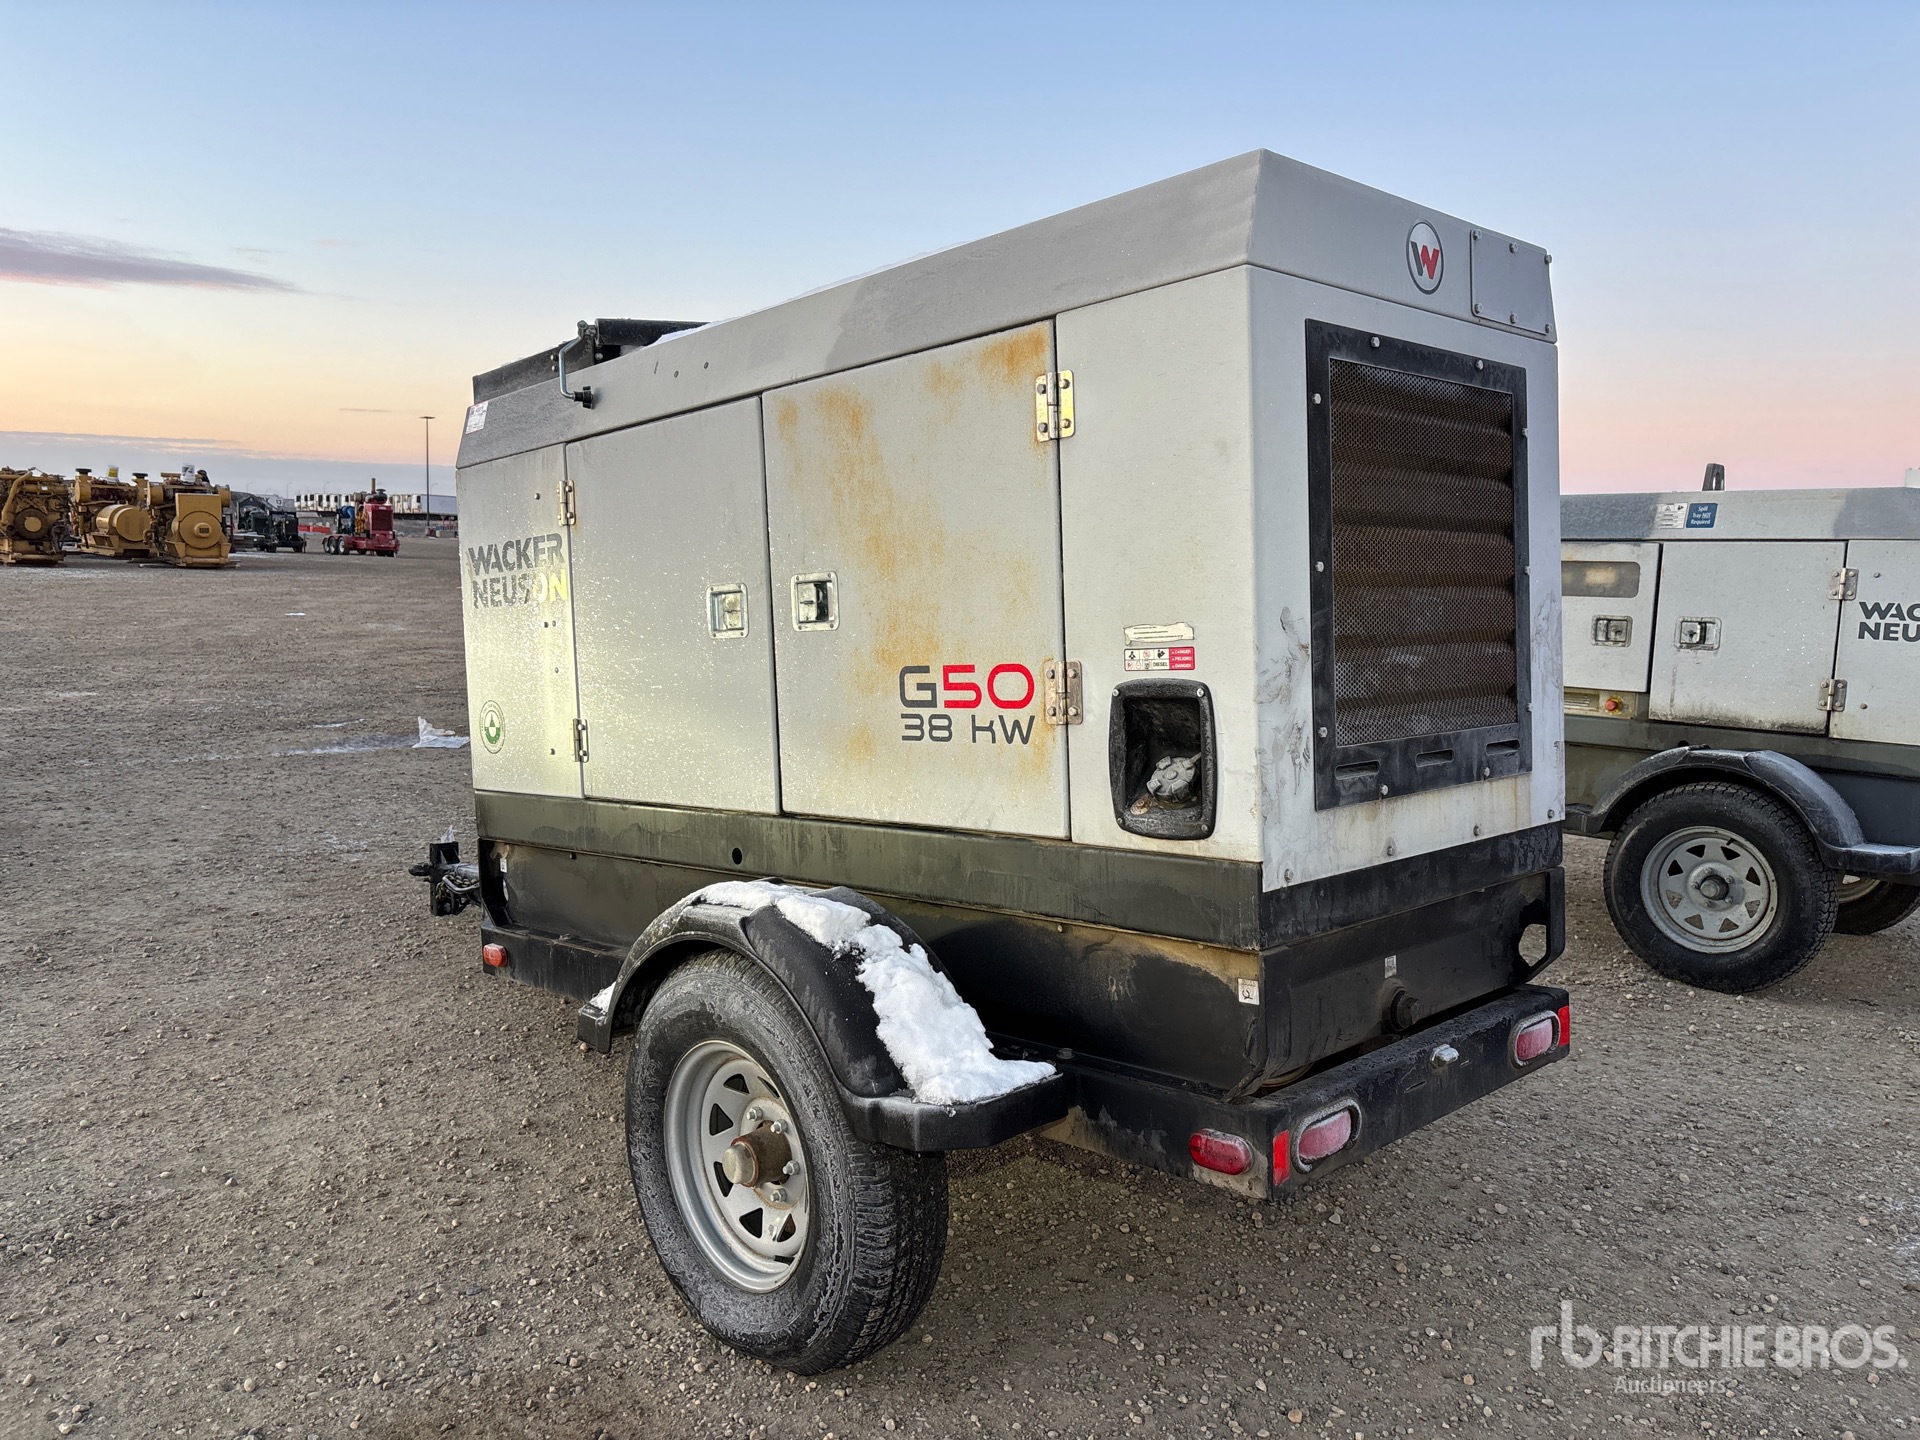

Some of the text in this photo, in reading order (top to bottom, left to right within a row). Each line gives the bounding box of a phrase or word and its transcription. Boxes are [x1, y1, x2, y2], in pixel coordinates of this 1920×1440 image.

[468, 533, 565, 576] WACKER
[472, 569, 568, 609] NEUSON
[899, 664, 1035, 709] G50
[901, 713, 953, 742] 38
